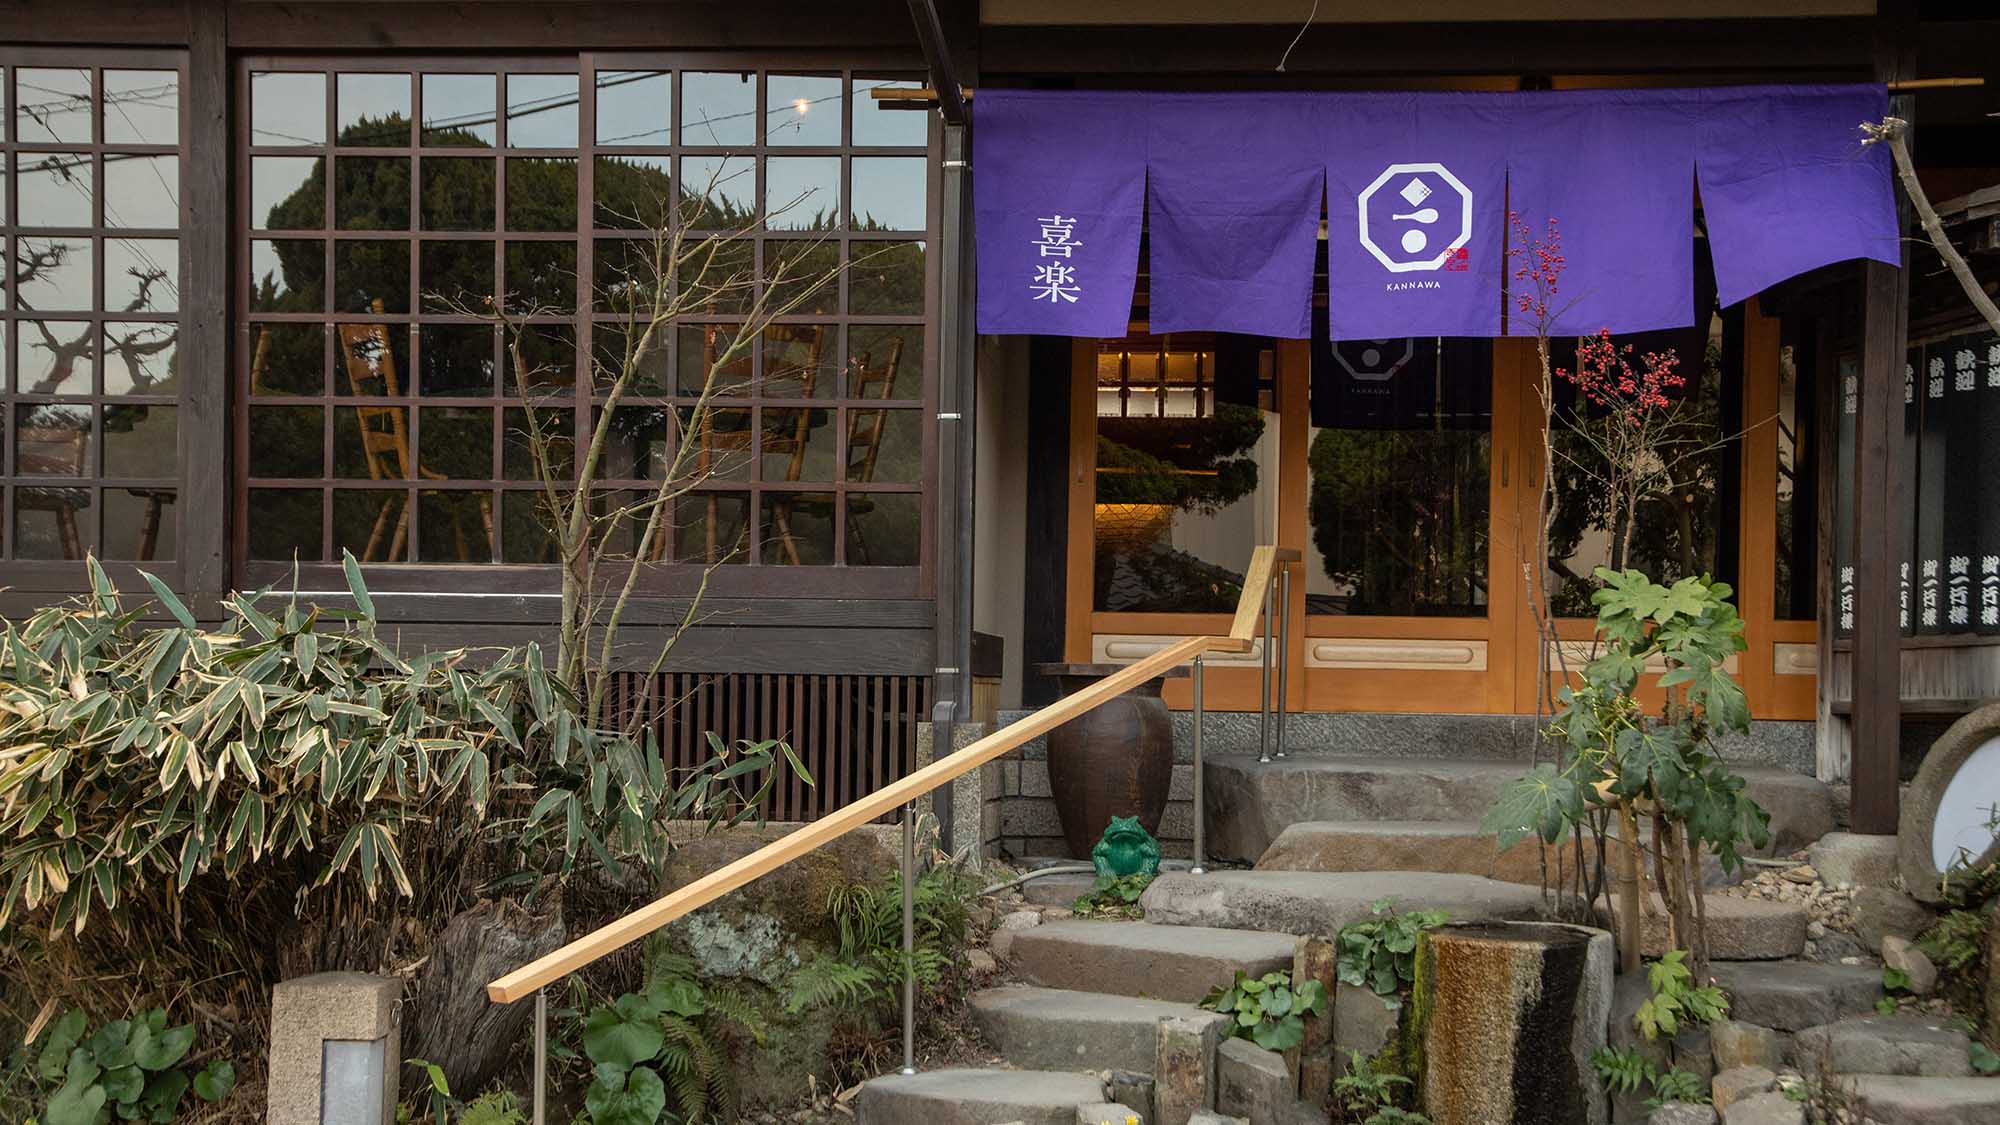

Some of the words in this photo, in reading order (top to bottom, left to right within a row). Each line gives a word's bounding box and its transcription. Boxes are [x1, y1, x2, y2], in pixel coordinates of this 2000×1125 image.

[1029, 215, 1083, 303] 喜楽
[1386, 281, 1441, 291] KANNAWA
[1955, 349, 1976, 391] 歓迎
[1948, 555, 1970, 625] 御一行様
